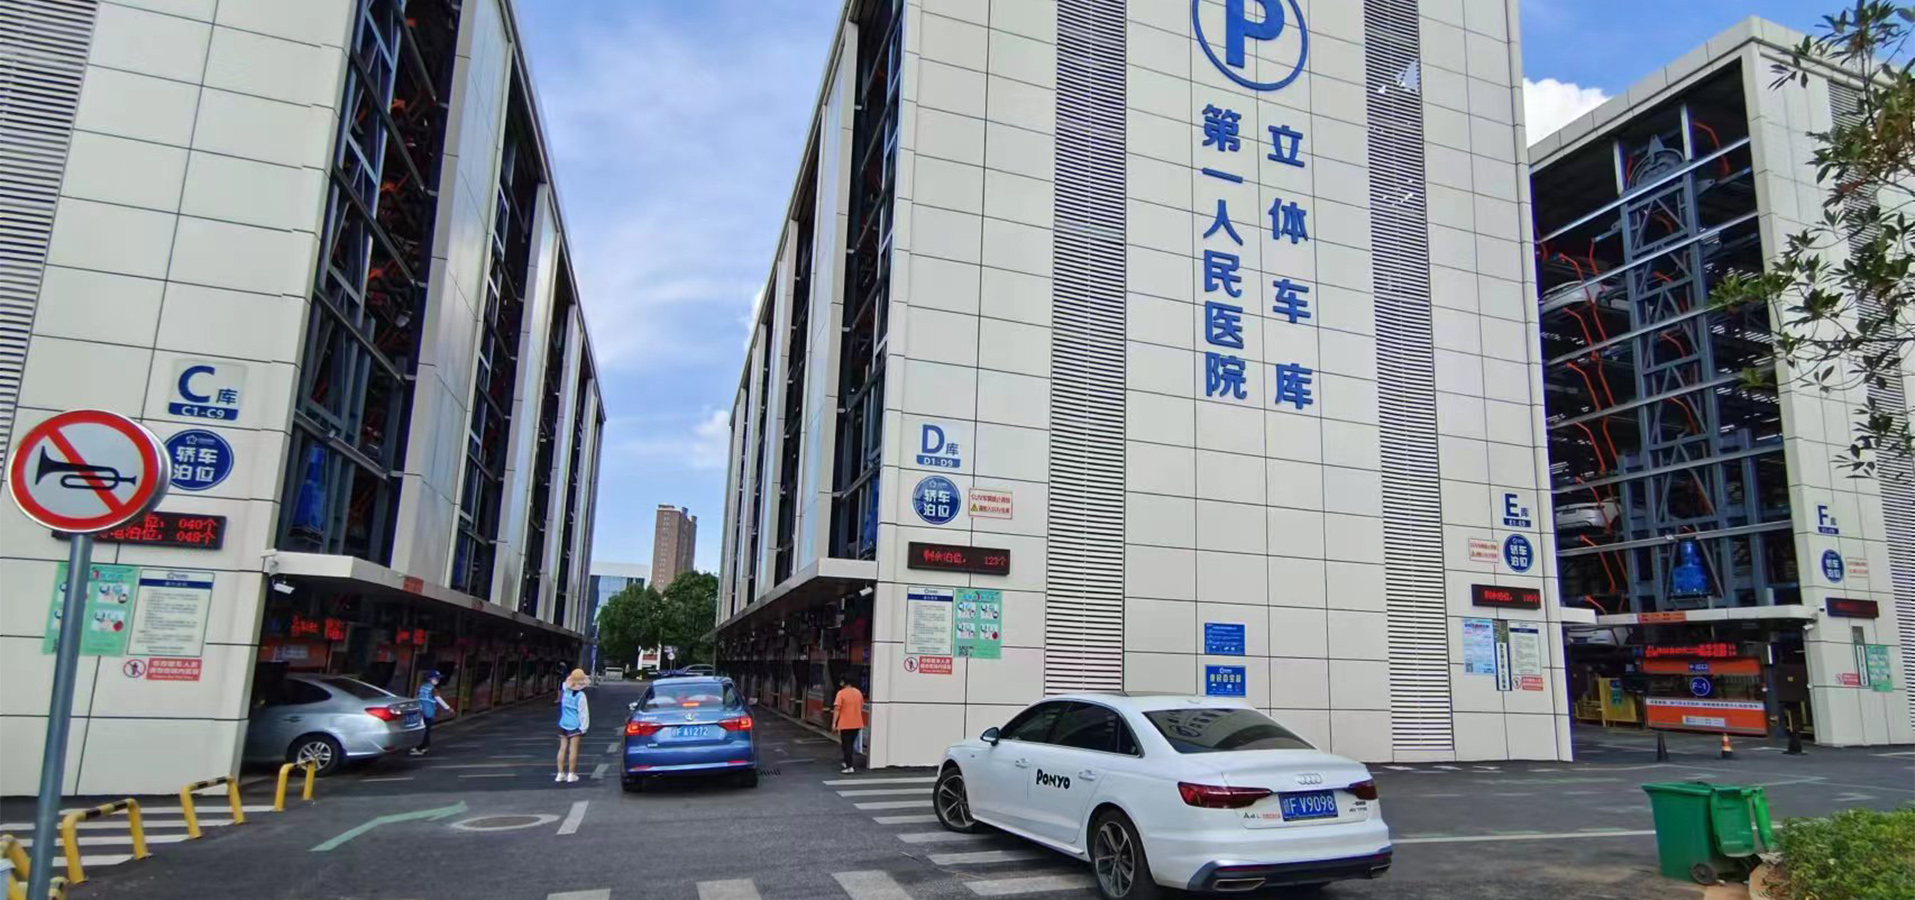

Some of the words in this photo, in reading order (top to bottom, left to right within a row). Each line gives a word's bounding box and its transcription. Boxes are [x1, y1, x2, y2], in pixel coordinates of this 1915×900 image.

[1226, 0, 1285, 68] P
[1202, 103, 1247, 400] 第一人民医院
[1267, 125, 1313, 410] 立体车库
[181, 406, 225, 419] C1-C9
[176, 446, 218, 464] 轿车
[924, 457, 953, 467] D1-D9
[172, 464, 215, 482] 泊位
[924, 489, 950, 503] 轿车
[923, 503, 950, 517] 泊位
[1036, 768, 1070, 790] PONYO
